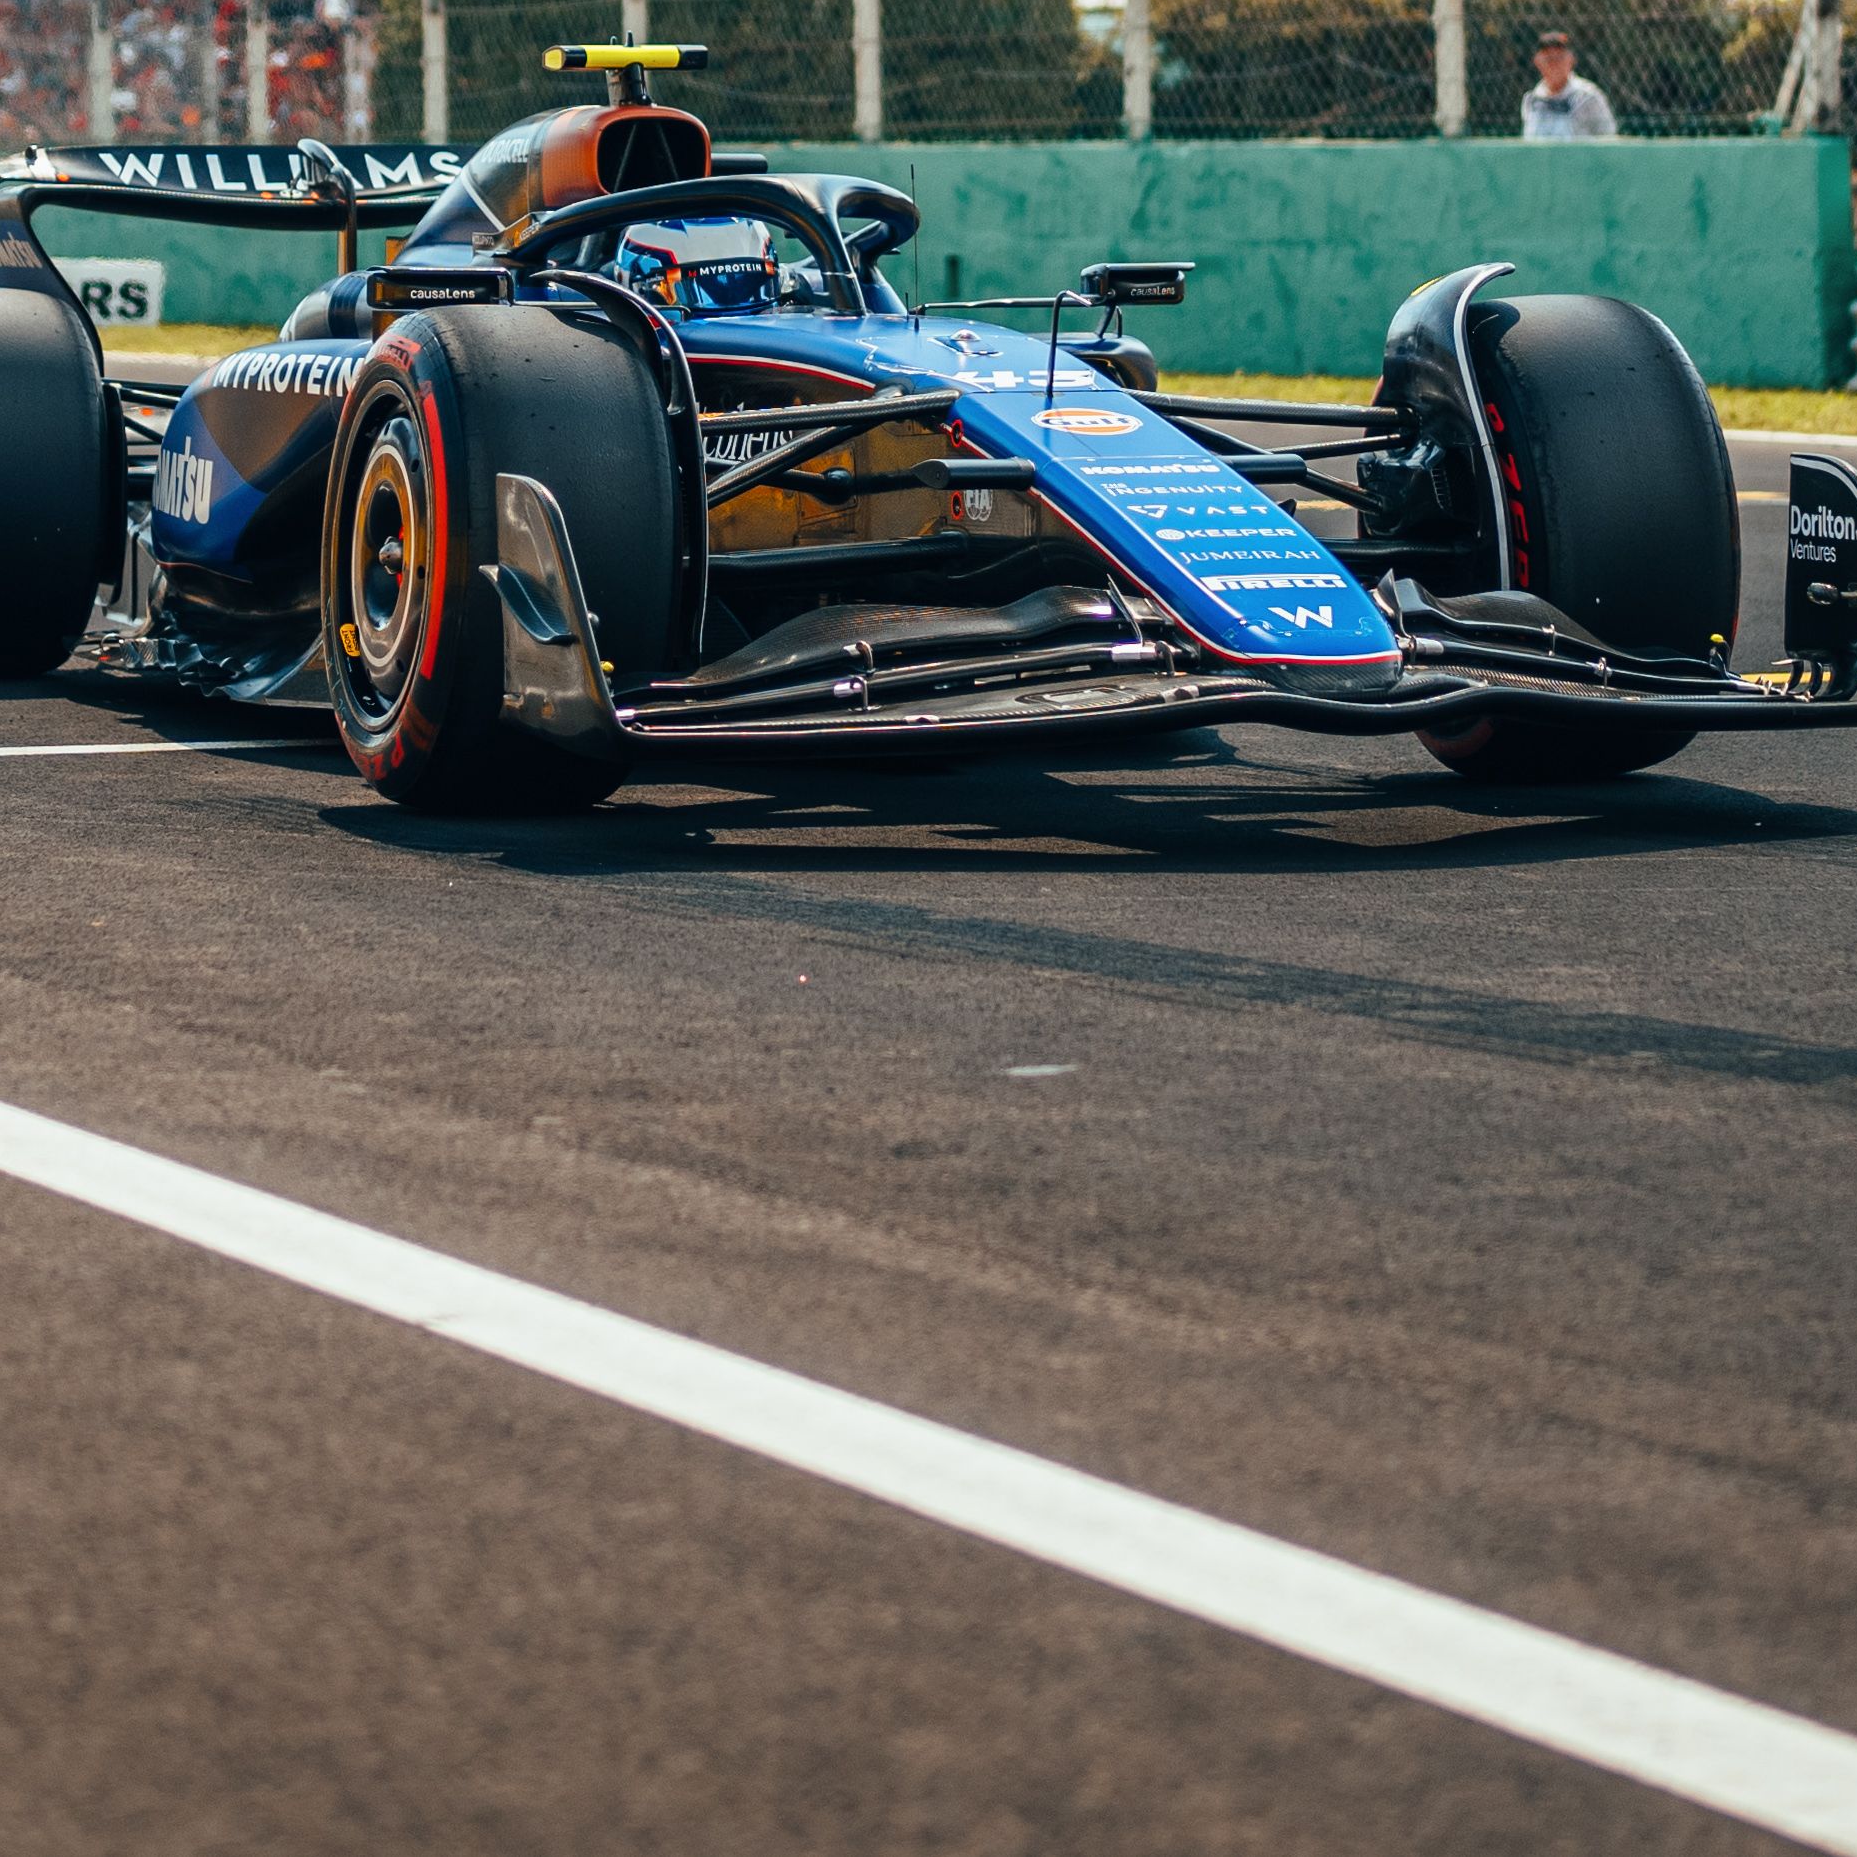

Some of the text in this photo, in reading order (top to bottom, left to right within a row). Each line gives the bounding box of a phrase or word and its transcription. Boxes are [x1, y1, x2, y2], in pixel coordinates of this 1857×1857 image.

[699, 263, 762, 276] MYPROTEIN
[81, 278, 149, 320] RS
[213, 352, 366, 397] MYPROTEIN
[954, 369, 1094, 388] 43
[1080, 463, 1220, 475] KOMATSU
[1106, 485, 1242, 497] INGENUITY
[1177, 505, 1268, 516] VAST
[1790, 505, 1856, 541] Dorilton
[1186, 528, 1298, 538] KEEPER
[1179, 550, 1321, 564] JUMEIRAH
[1790, 538, 1837, 563] Ventures
[1199, 573, 1347, 591] PIRELLI
